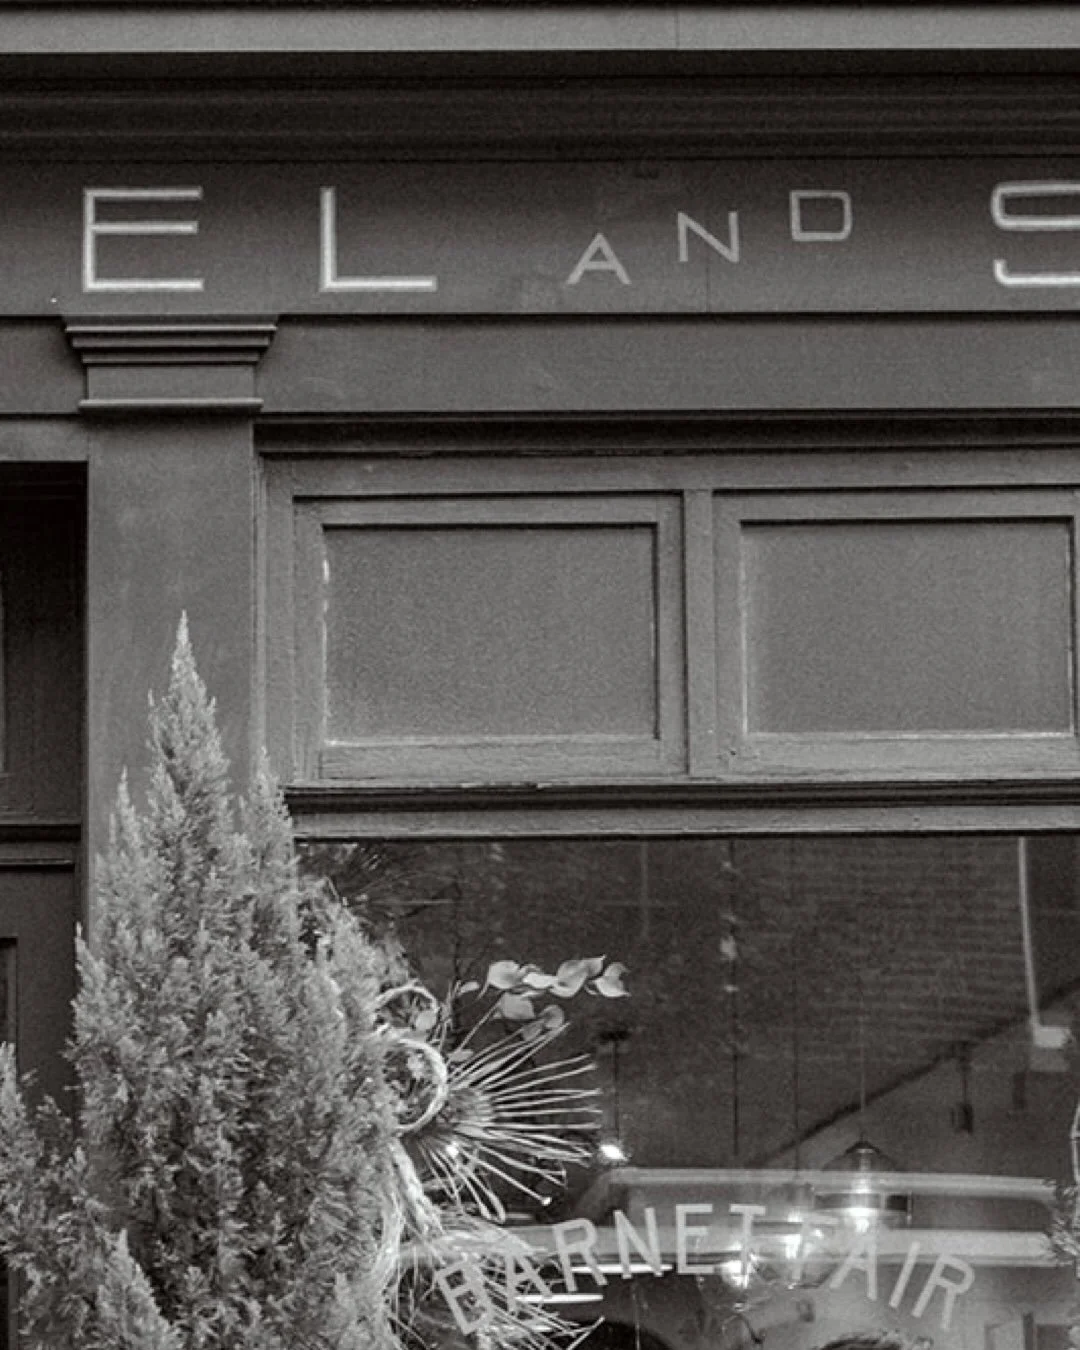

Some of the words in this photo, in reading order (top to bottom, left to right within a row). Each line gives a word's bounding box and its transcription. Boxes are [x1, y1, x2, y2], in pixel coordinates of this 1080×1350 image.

[567, 189, 852, 286] AND
[434, 1203, 766, 1334] BARNET
[791, 1214, 976, 1330] FAIR
